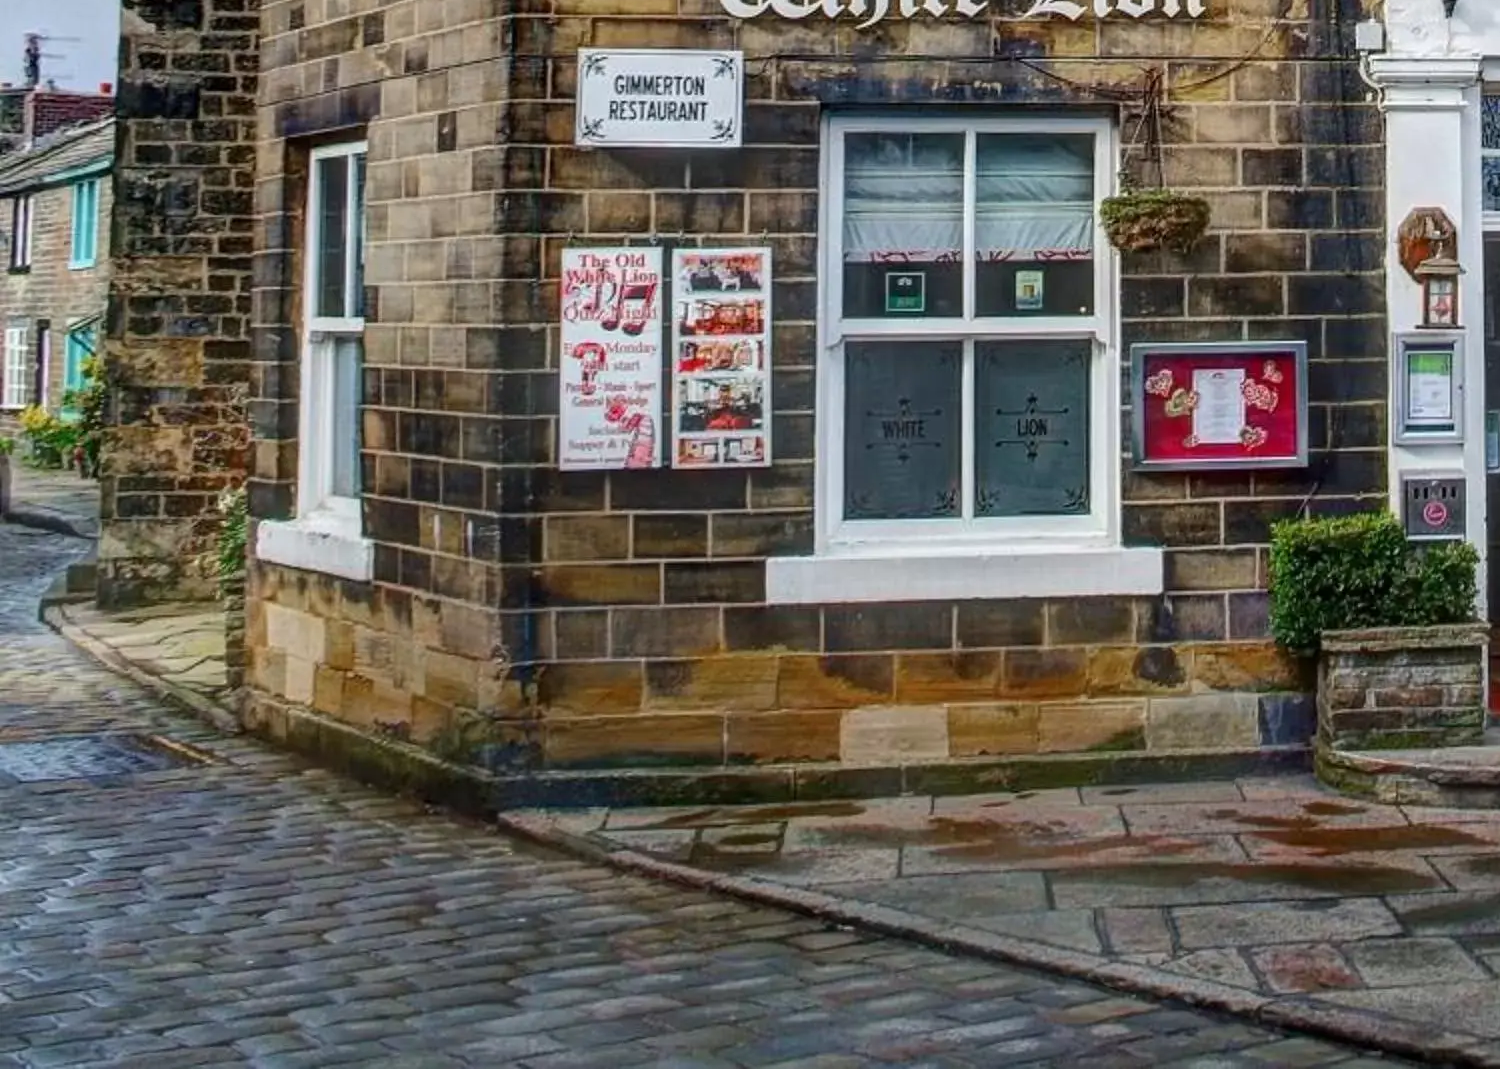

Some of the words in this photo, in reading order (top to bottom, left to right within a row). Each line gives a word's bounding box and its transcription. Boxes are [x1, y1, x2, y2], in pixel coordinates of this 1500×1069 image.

[614, 74, 705, 96] GIMMERTON
[608, 100, 708, 122] RESTAURANT
[578, 254, 610, 268] The
[615, 253, 645, 268] Old
[566, 270, 615, 284] White
[621, 269, 657, 284] Lion
[605, 340, 657, 357] Monday
[614, 360, 640, 371] start
[882, 419, 926, 439] WHITE
[1017, 418, 1048, 436] LION
